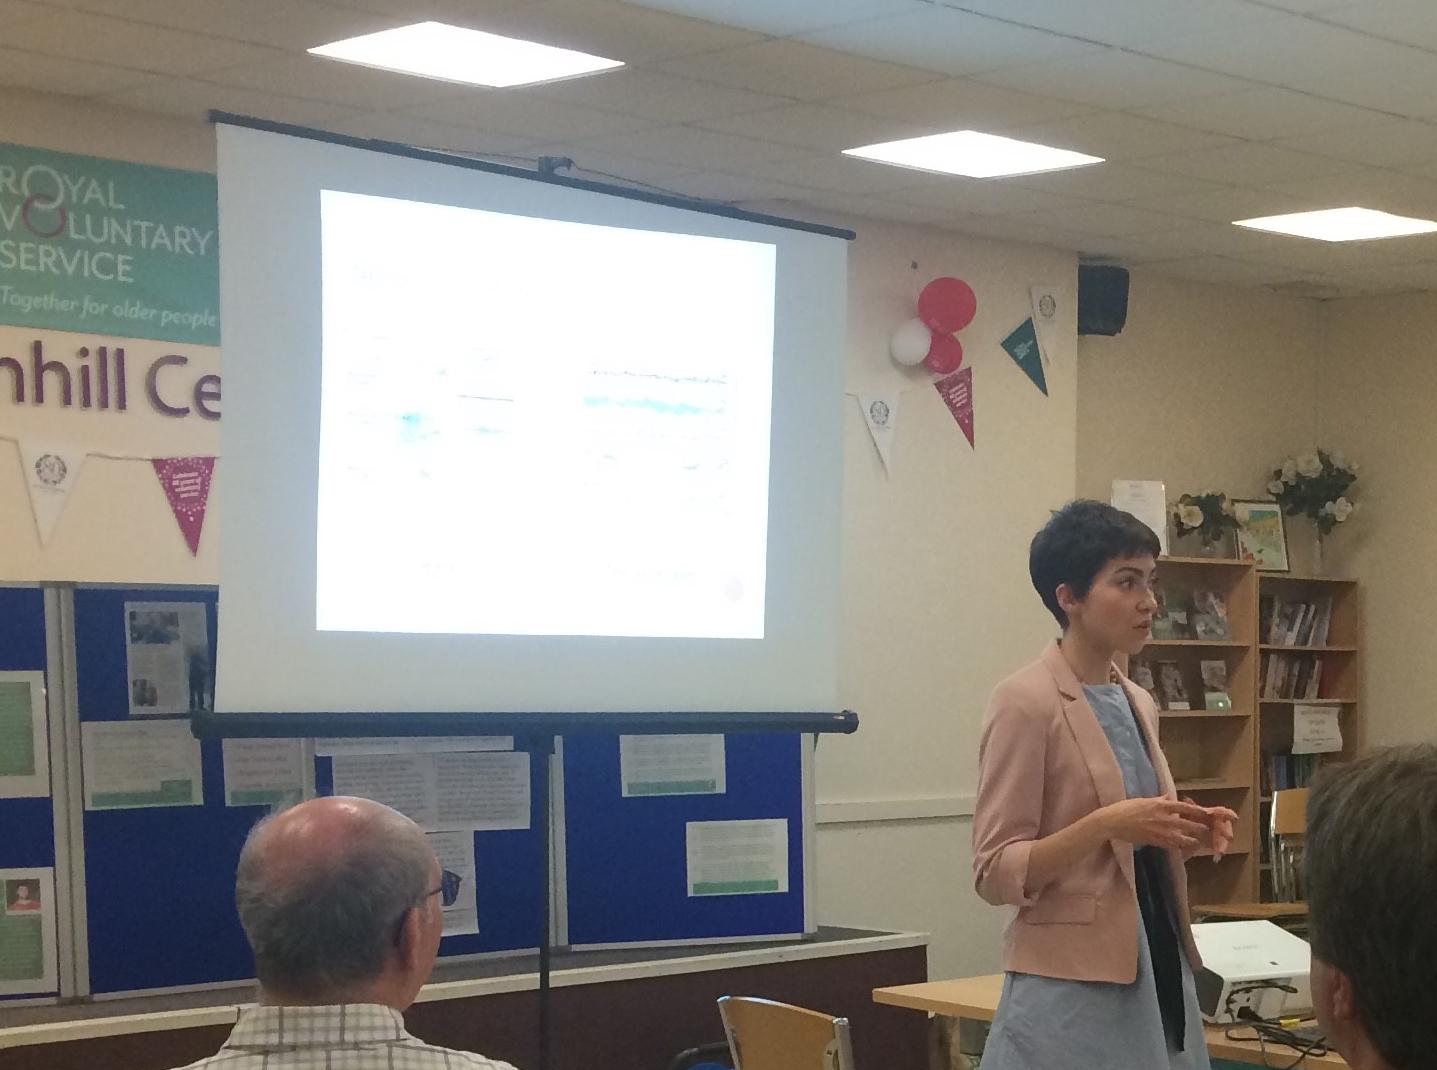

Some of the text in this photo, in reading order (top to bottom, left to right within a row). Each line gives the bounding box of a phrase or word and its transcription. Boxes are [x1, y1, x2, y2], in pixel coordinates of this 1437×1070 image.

[0, 164, 125, 209] ROYAL
[0, 193, 213, 255] VOLUNTARY
[0, 240, 134, 283] SERVICE
[1, 285, 218, 329] Together for older people
